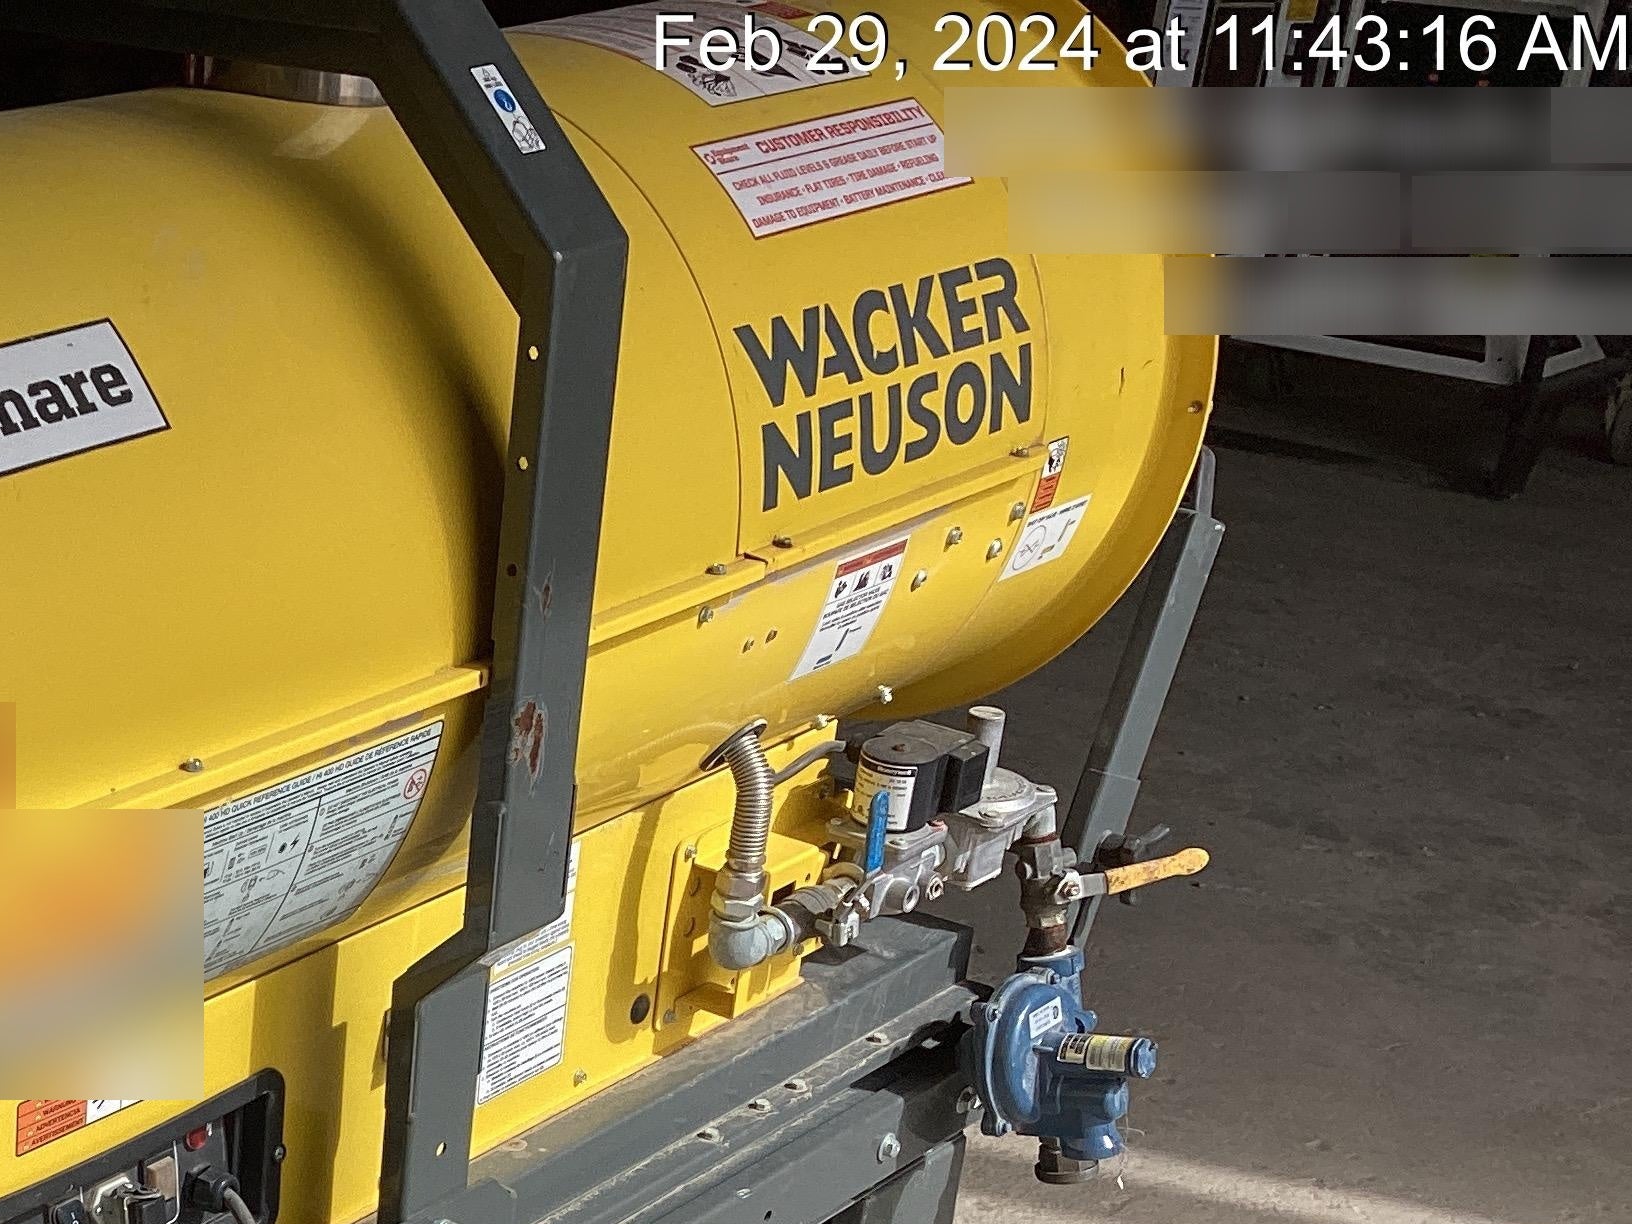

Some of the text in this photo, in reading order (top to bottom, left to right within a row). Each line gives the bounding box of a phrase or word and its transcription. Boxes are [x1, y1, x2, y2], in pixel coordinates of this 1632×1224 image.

[754, 105, 926, 154] CUSTOMER RESPONSIBILITY
[751, 211, 788, 229] DAMAGE
[732, 256, 1031, 408] WACKER
[761, 342, 1032, 513] NEUSON
